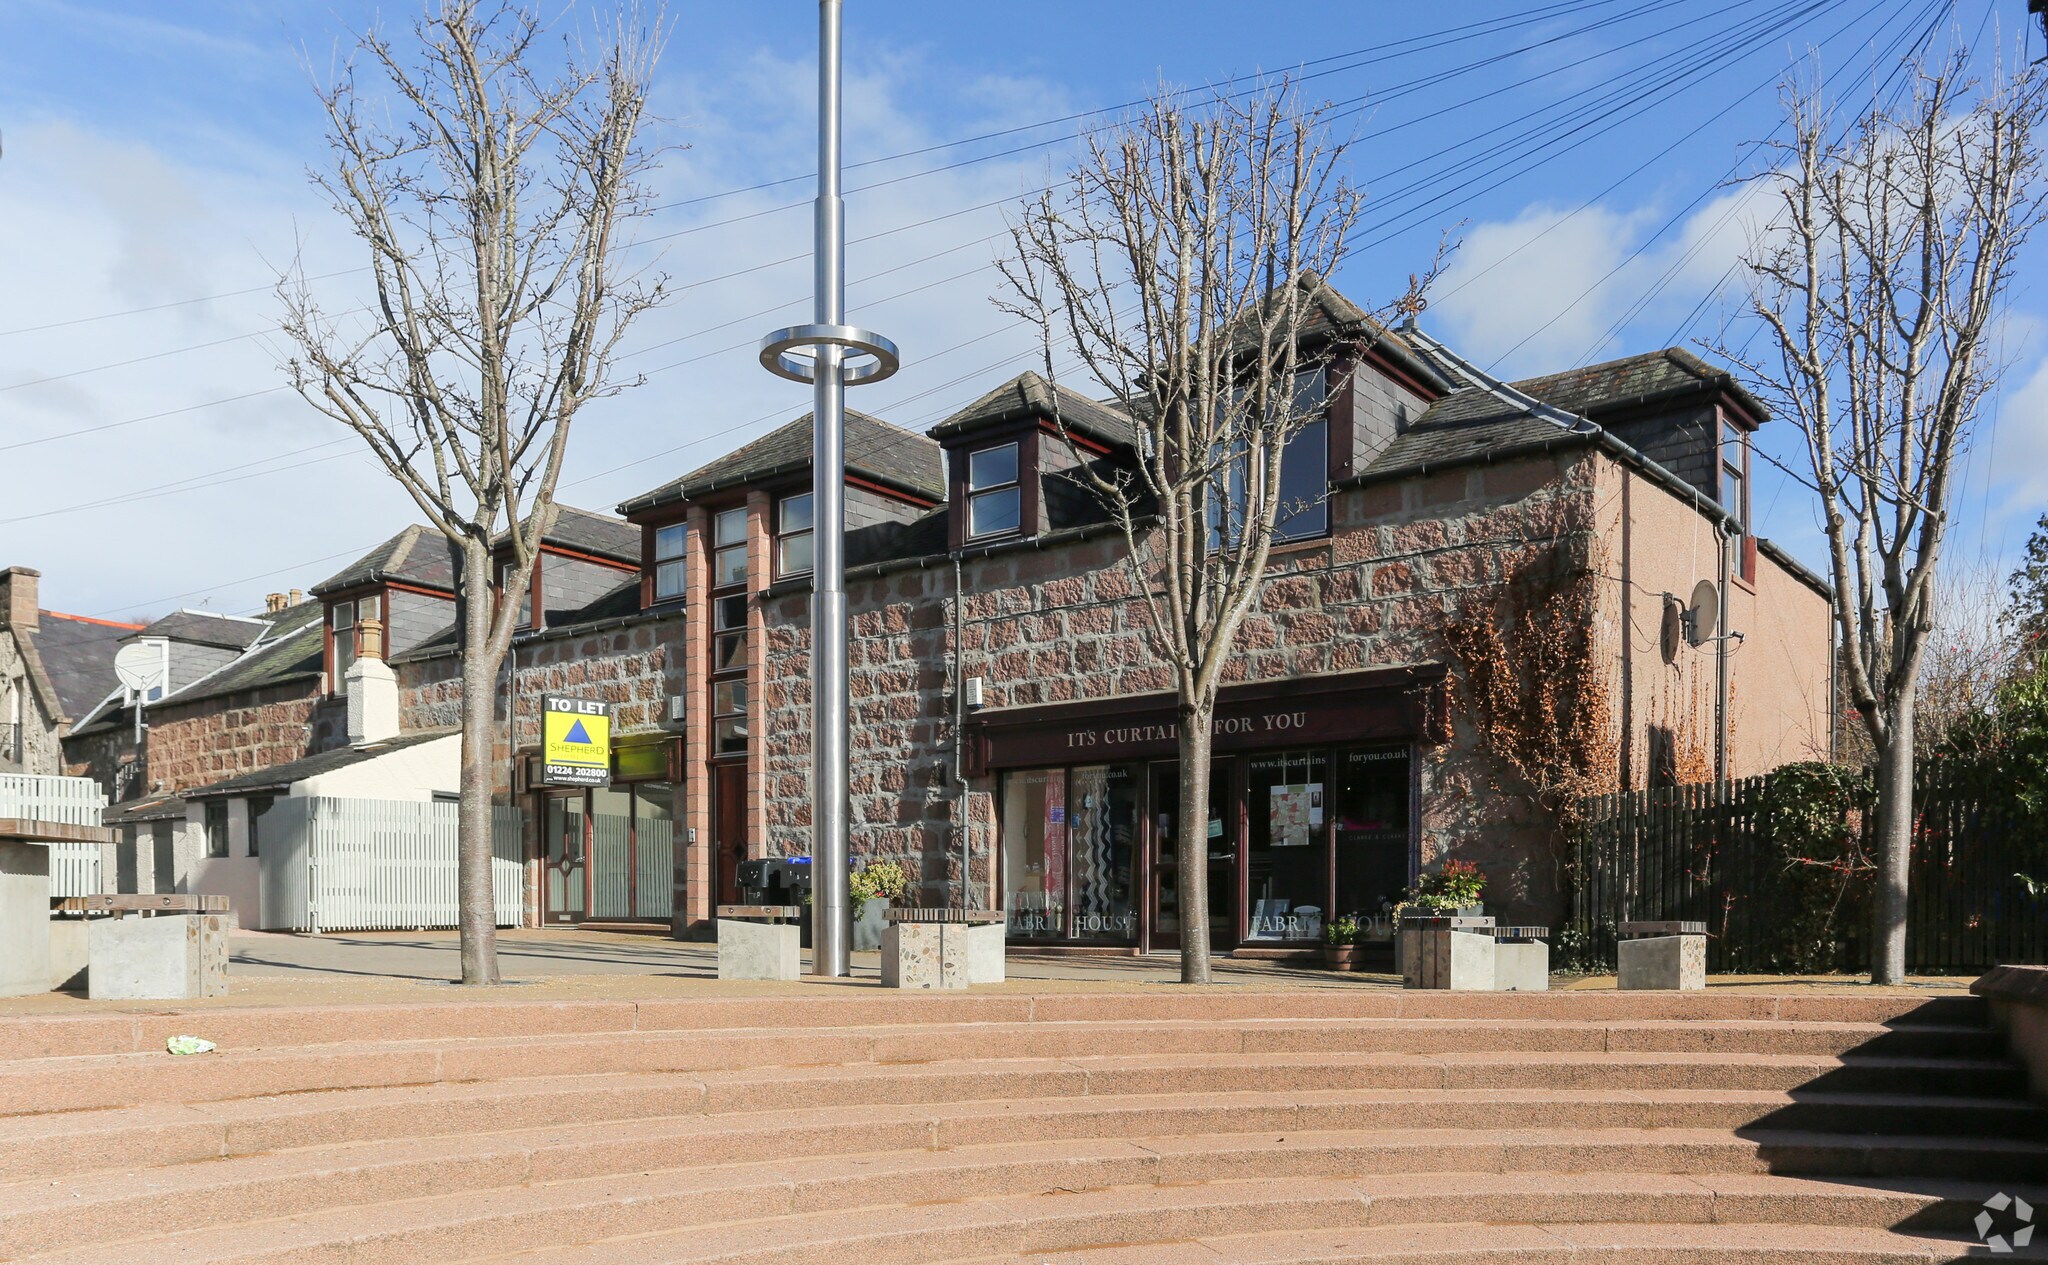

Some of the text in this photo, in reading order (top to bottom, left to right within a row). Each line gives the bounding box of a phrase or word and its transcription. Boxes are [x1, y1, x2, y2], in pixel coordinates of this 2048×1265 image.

[548, 698, 606, 715] TO LET
[1067, 712, 1307, 747] IT'S CURTAI FOR YOU
[1250, 755, 1326, 768] www.itscurtains
[1349, 749, 1408, 764] foryou.co.uk
[547, 765, 607, 778] 01224 202800
